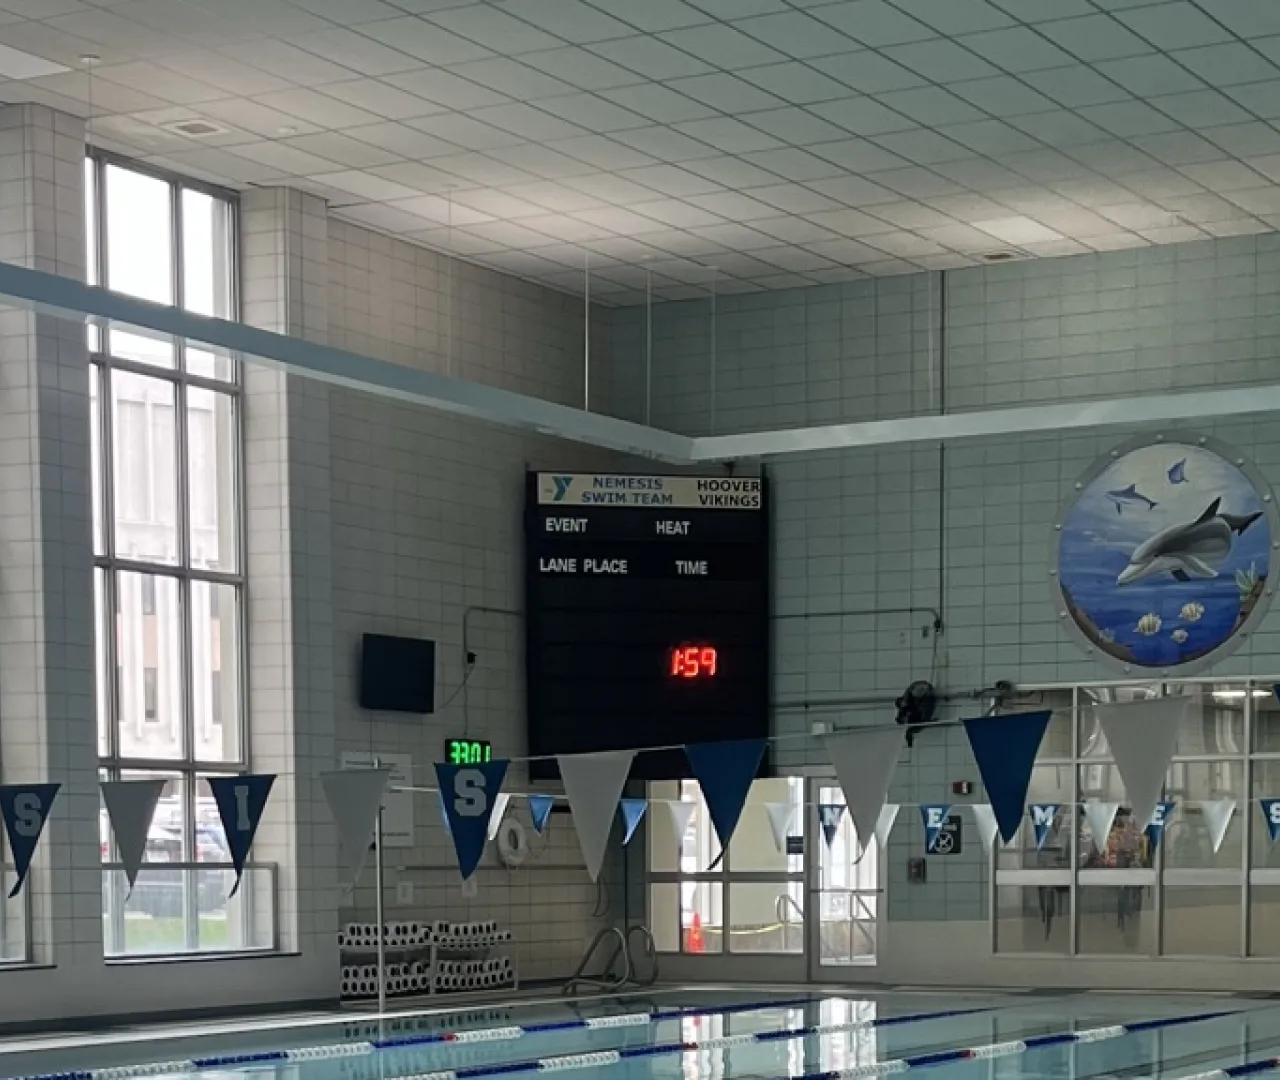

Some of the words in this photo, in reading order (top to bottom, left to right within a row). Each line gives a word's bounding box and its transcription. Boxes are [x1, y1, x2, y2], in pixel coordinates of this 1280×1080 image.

[592, 477, 664, 490] NEMESIS
[696, 479, 761, 492] HOOVER
[581, 491, 627, 504] SWIM
[632, 492, 673, 505] TEAM
[698, 493, 760, 507] VIKINGS
[545, 516, 588, 533] EVENT
[655, 520, 691, 535] HEAT
[539, 557, 577, 573] LANE
[583, 558, 628, 574] PLACE
[675, 559, 709, 575] TIME
[671, 646, 717, 677] 1:59
[14, 793, 42, 837] S
[234, 785, 251, 832] I
[453, 768, 487, 817] S
[822, 807, 842, 826] N
[927, 807, 943, 828] E
[1033, 805, 1055, 826] M
[1150, 805, 1166, 826] E
